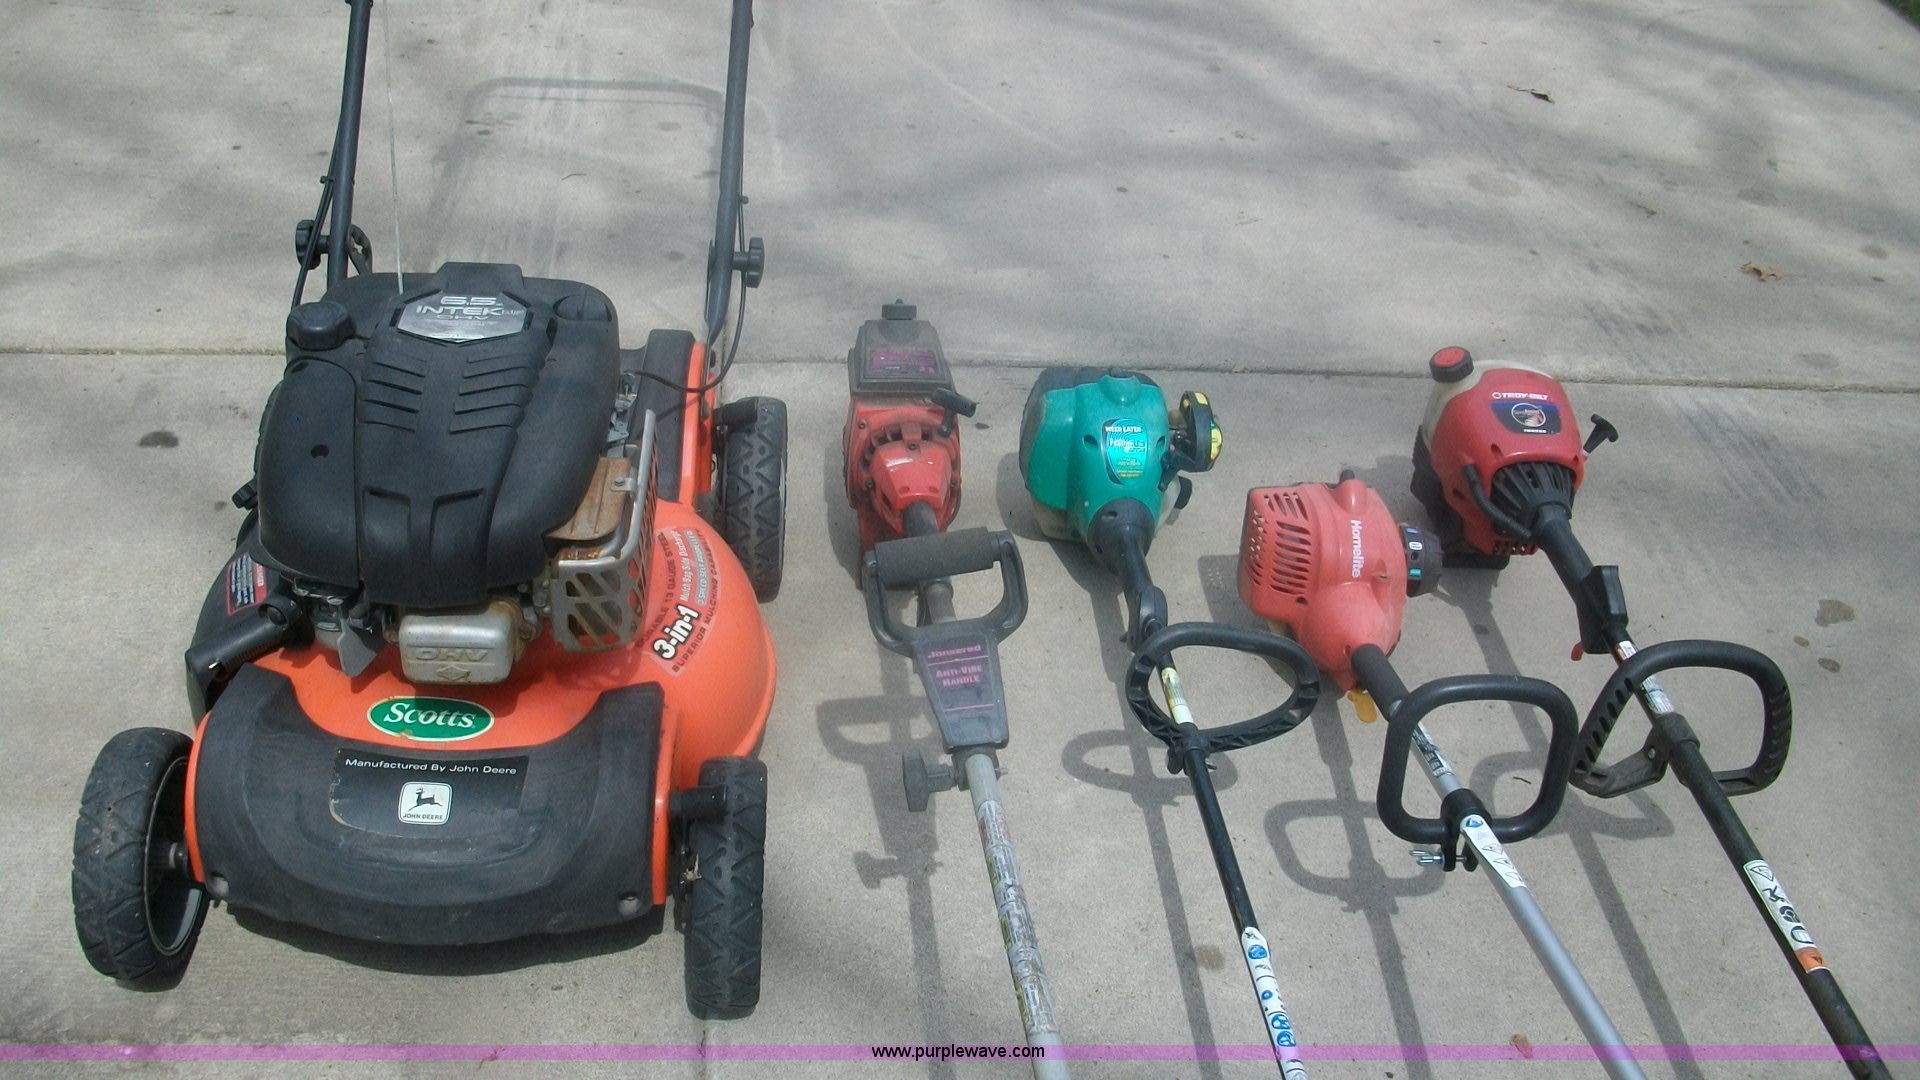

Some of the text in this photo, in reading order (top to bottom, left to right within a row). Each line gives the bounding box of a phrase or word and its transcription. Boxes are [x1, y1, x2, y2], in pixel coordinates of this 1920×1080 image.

[416, 305, 503, 316] INTEK
[441, 296, 497, 306] 6.5
[657, 532, 673, 558] STEEL
[1350, 519, 1365, 578] Homelite
[667, 559, 676, 590] GAUGE
[635, 606, 669, 648] DURABLE
[652, 603, 700, 660] 3-in-1
[672, 627, 706, 672] SUPERIOR
[704, 578, 718, 625] MULCHING
[928, 644, 981, 658] Jonsered
[942, 675, 981, 687] HANDLE
[383, 702, 476, 728] Scotts
[345, 758, 517, 774] Manufactured By John Deere
